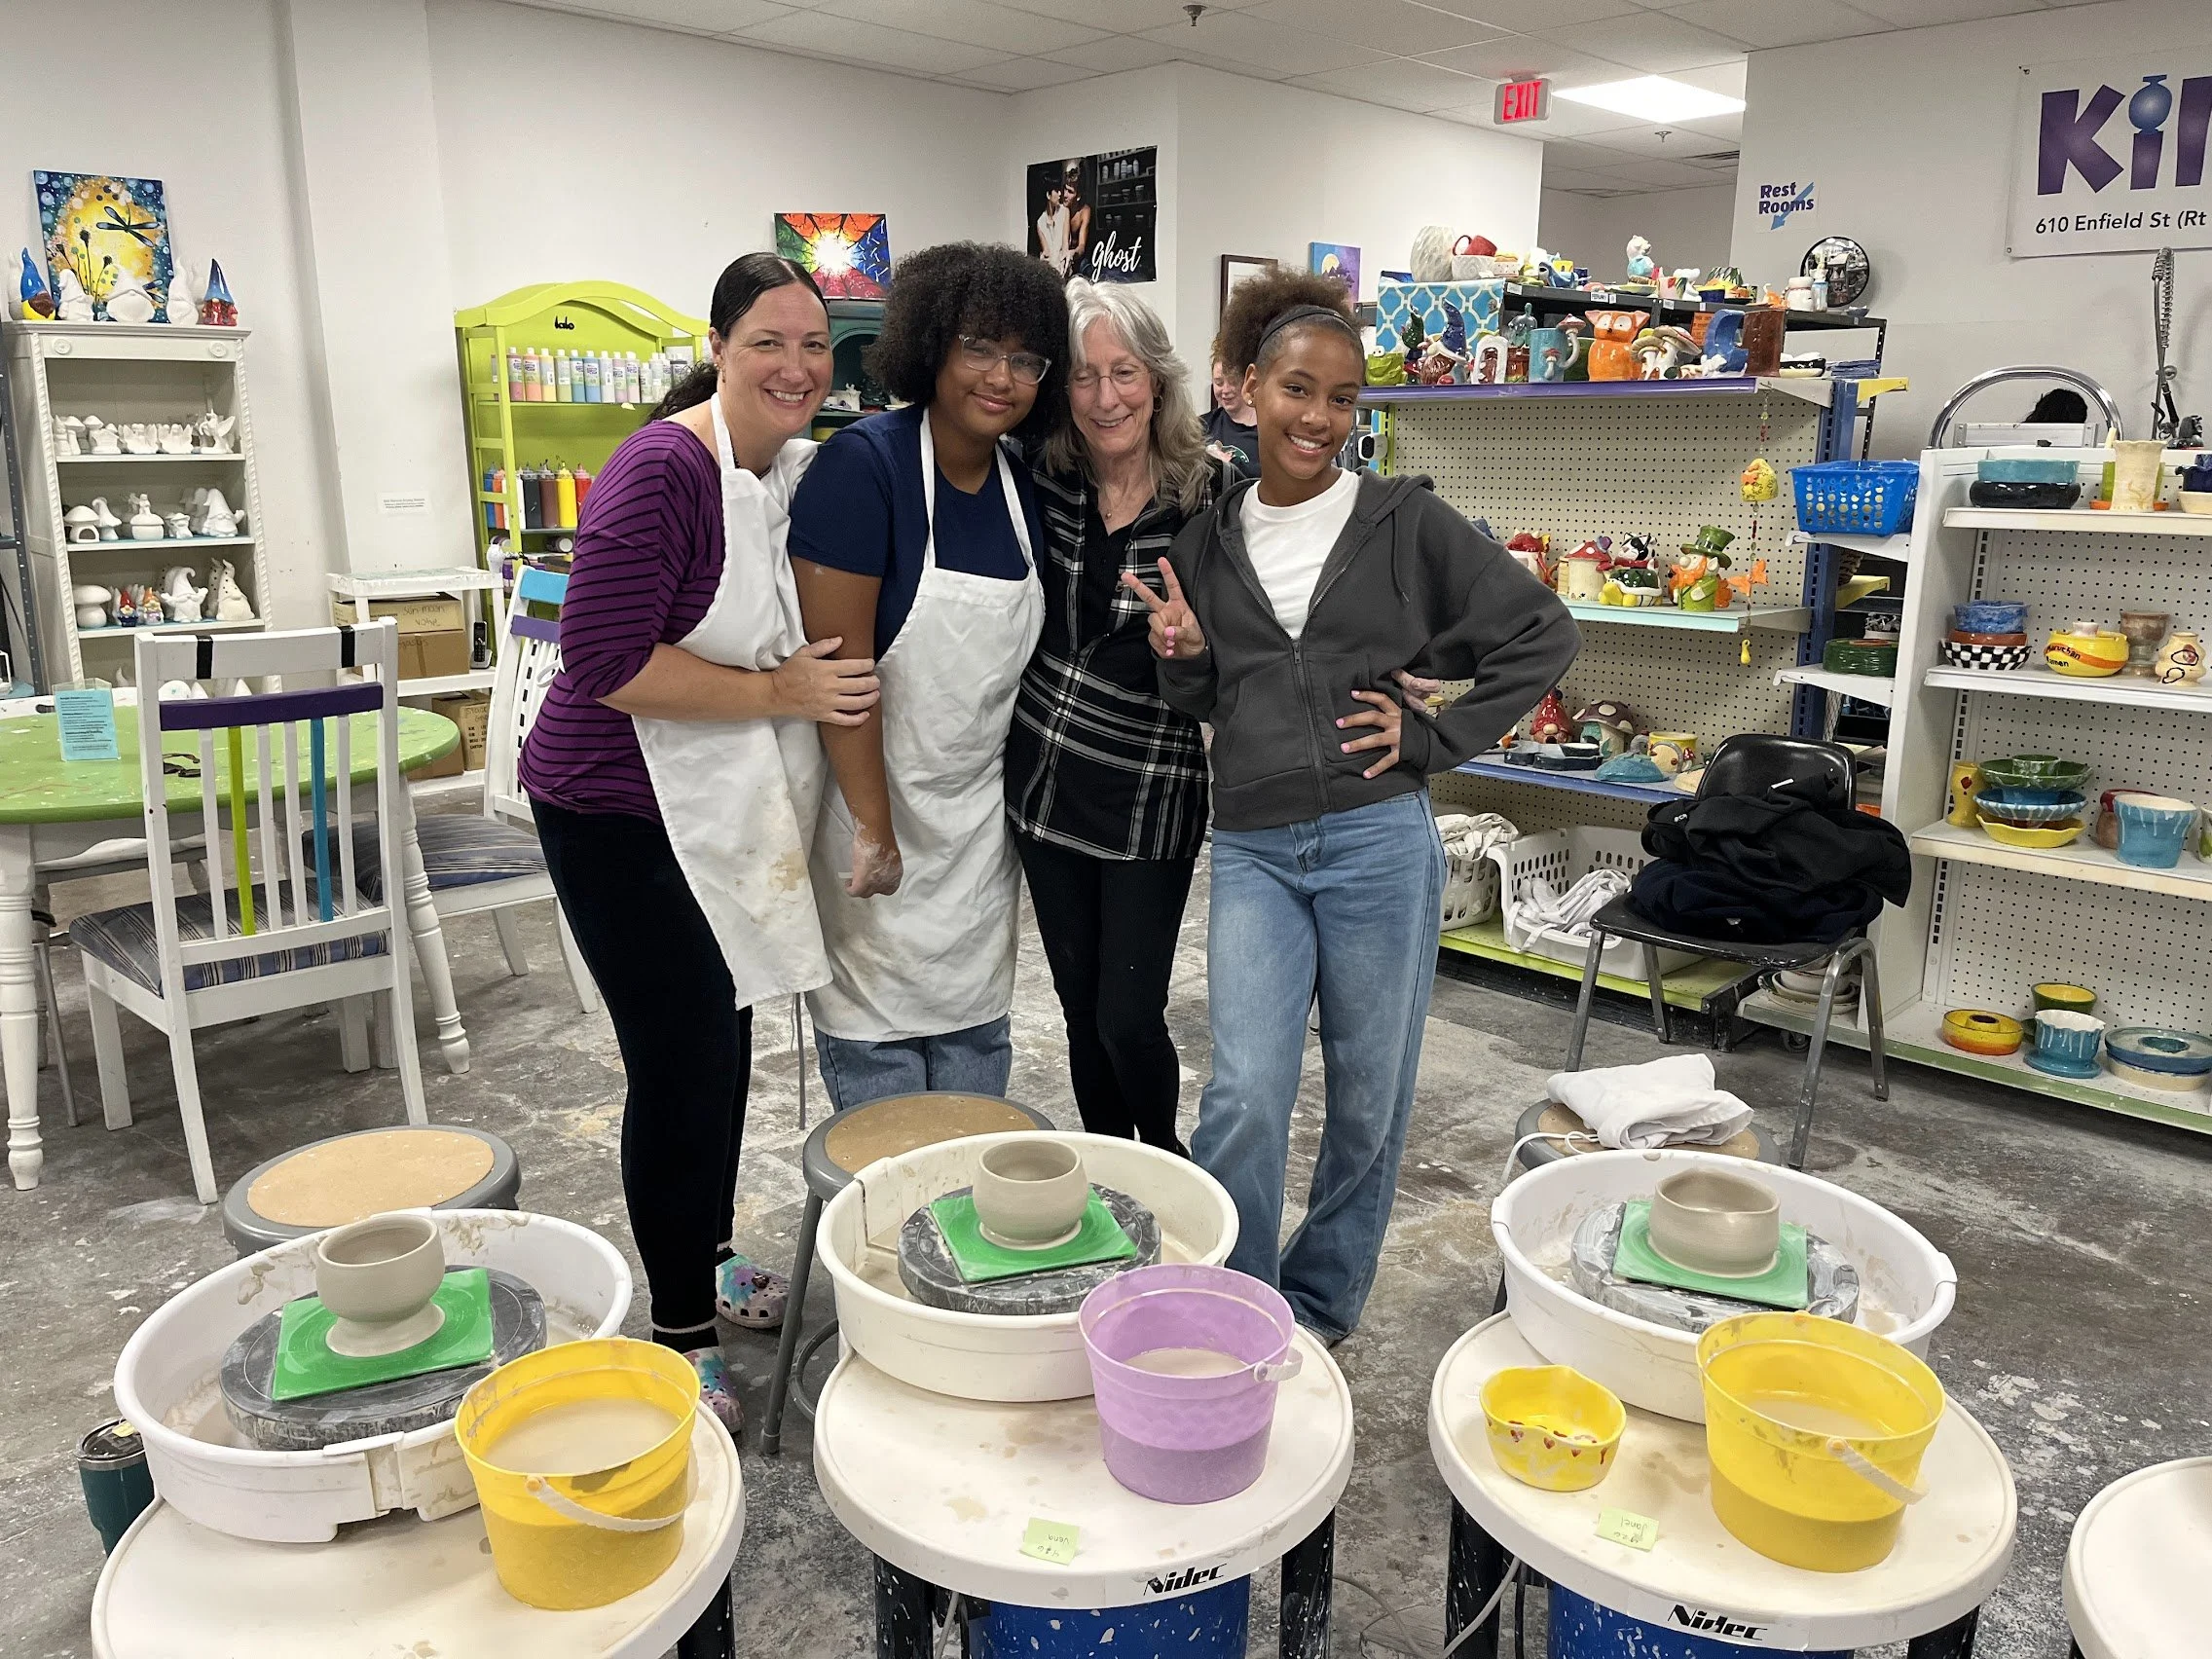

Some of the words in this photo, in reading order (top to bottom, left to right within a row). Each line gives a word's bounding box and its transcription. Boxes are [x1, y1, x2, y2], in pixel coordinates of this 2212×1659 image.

[1502, 80, 1542, 122] EXIT
[1760, 181, 1796, 199] Rest
[1758, 199, 1814, 214] Rooms
[2036, 216, 2069, 234] 610
[2075, 212, 2143, 232] Enfield
[2149, 211, 2170, 228] St
[2178, 210, 2207, 230] (Rt
[1143, 1563, 1228, 1597] Nidec
[1667, 1604, 1768, 1641] Nidec
